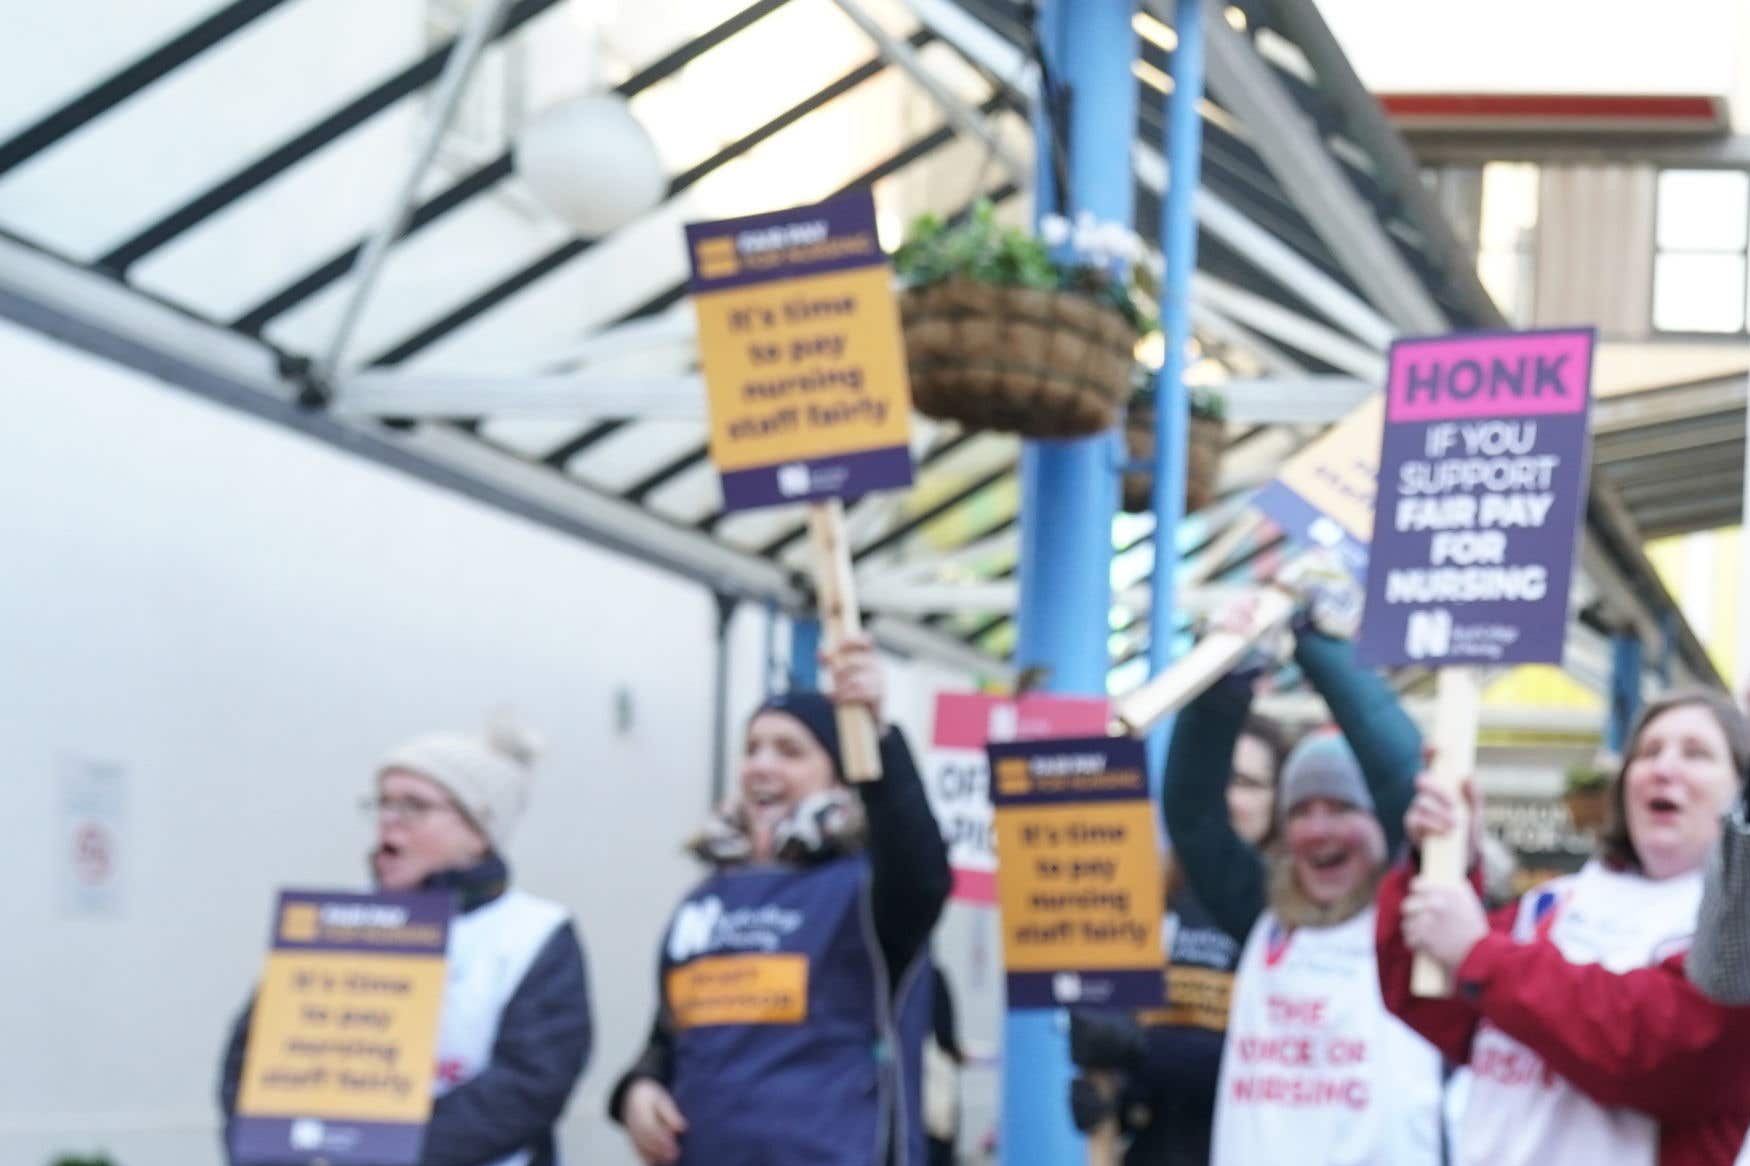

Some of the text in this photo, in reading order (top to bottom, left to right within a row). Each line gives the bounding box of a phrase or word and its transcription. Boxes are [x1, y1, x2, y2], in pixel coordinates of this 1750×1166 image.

[783, 295, 855, 323] time
[788, 332, 846, 360] pay
[742, 368, 864, 400] nursing
[1406, 354, 1570, 404] HONK
[728, 398, 890, 440] staff fairly
[1425, 420, 1538, 457] IF YOU
[1398, 454, 1560, 494] SUPPORT
[1396, 492, 1555, 531] FAIR PAY
[1430, 530, 1506, 565] FOR
[1385, 565, 1548, 603] NURSING
[1031, 890, 1128, 912] nursing
[1266, 996, 1328, 1026] THE
